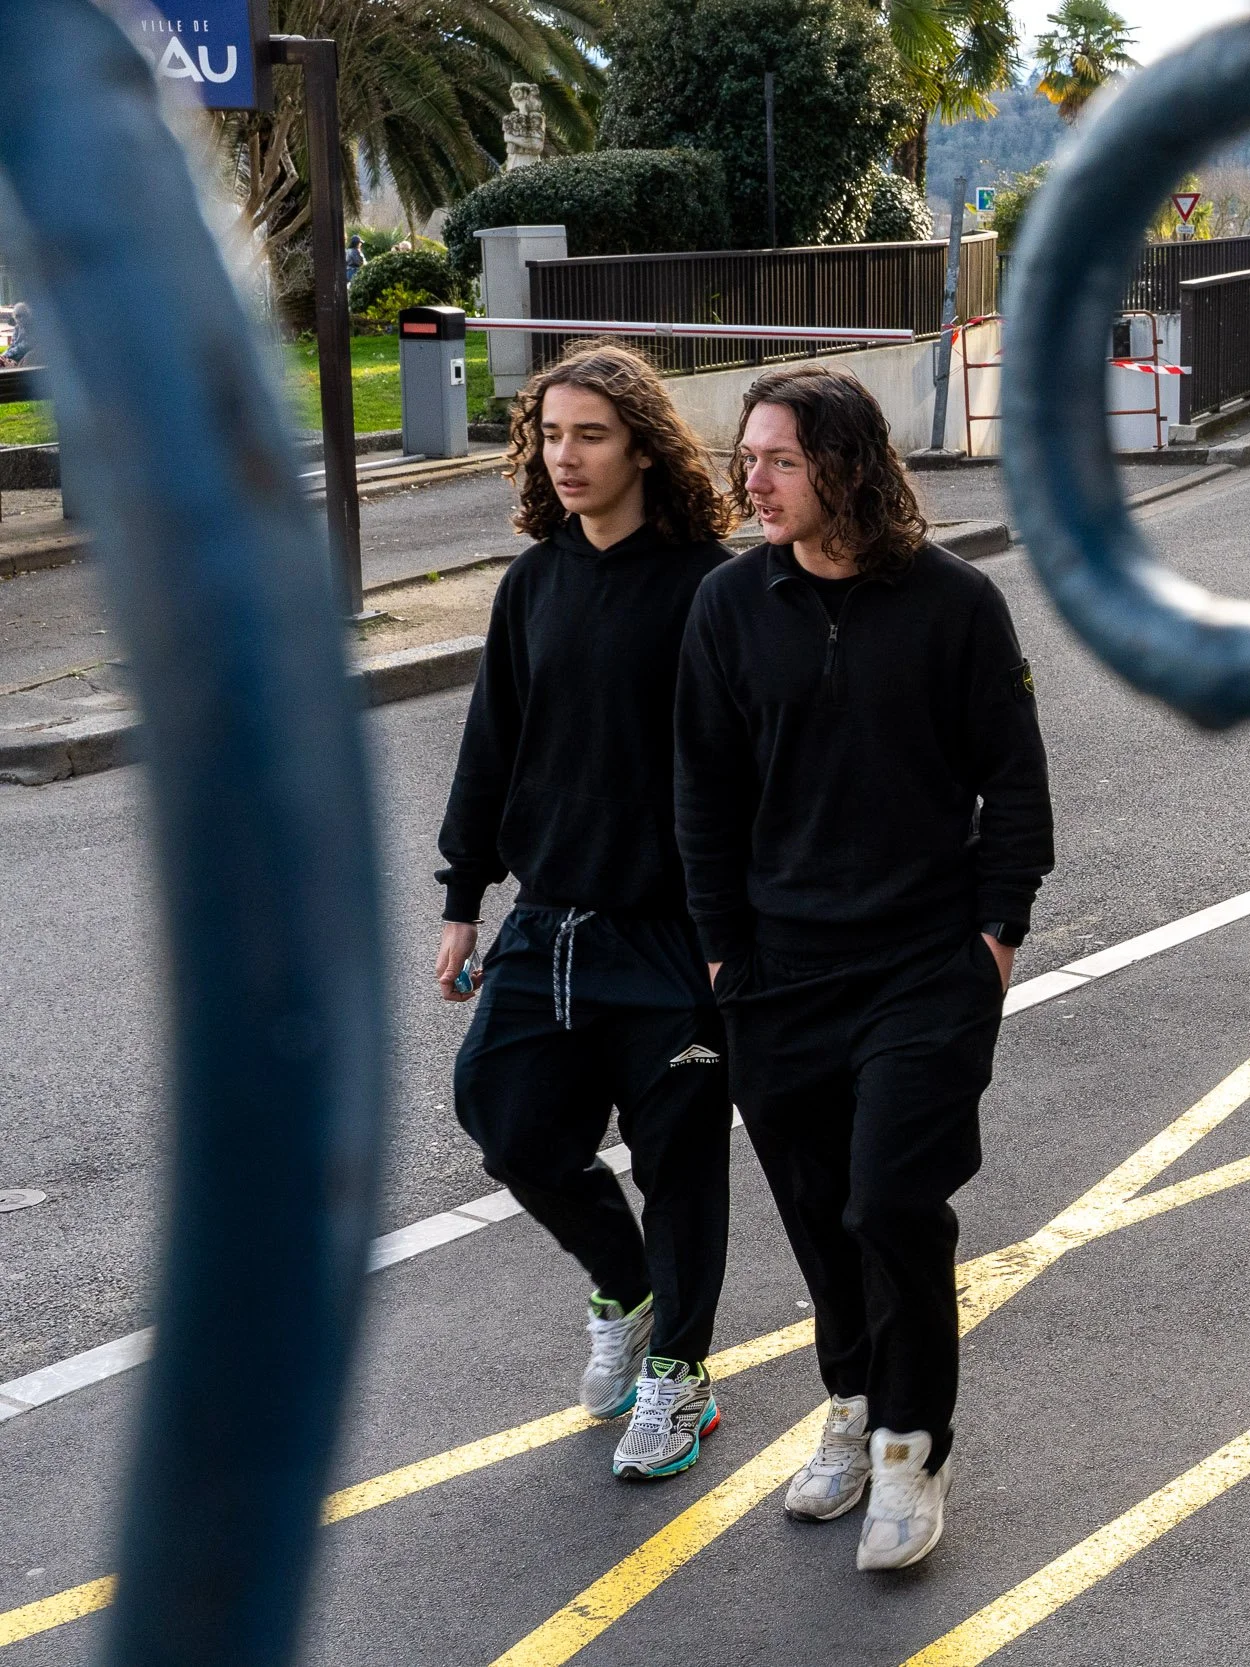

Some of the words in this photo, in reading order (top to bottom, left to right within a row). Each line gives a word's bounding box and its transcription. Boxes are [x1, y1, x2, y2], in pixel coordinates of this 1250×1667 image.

[141, 20, 182, 32] VILLE
[193, 20, 209, 32] DE
[157, 36, 238, 83] AU
